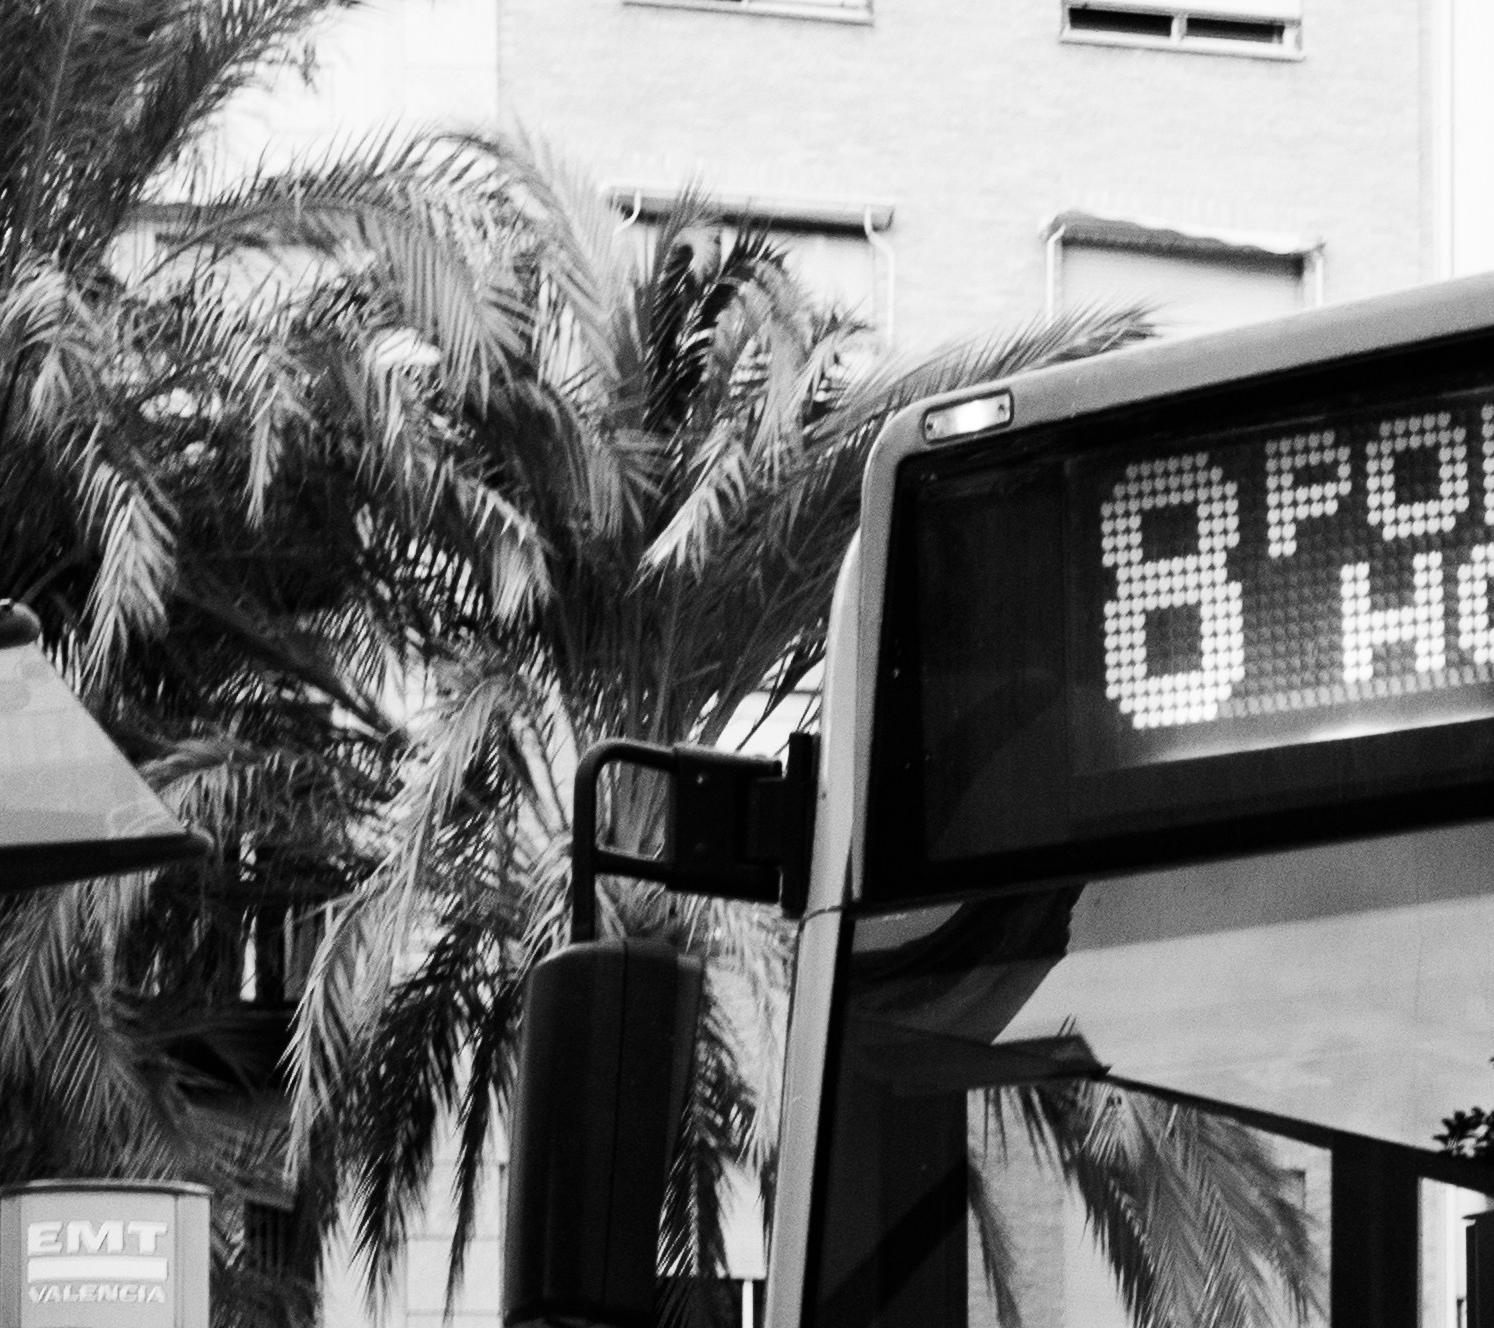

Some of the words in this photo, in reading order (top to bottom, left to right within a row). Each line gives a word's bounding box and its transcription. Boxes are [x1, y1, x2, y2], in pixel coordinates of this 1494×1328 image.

[1101, 452, 1245, 730] 8
[26, 1219, 168, 1257] EMT
[27, 1283, 167, 1304] VALENCIA
